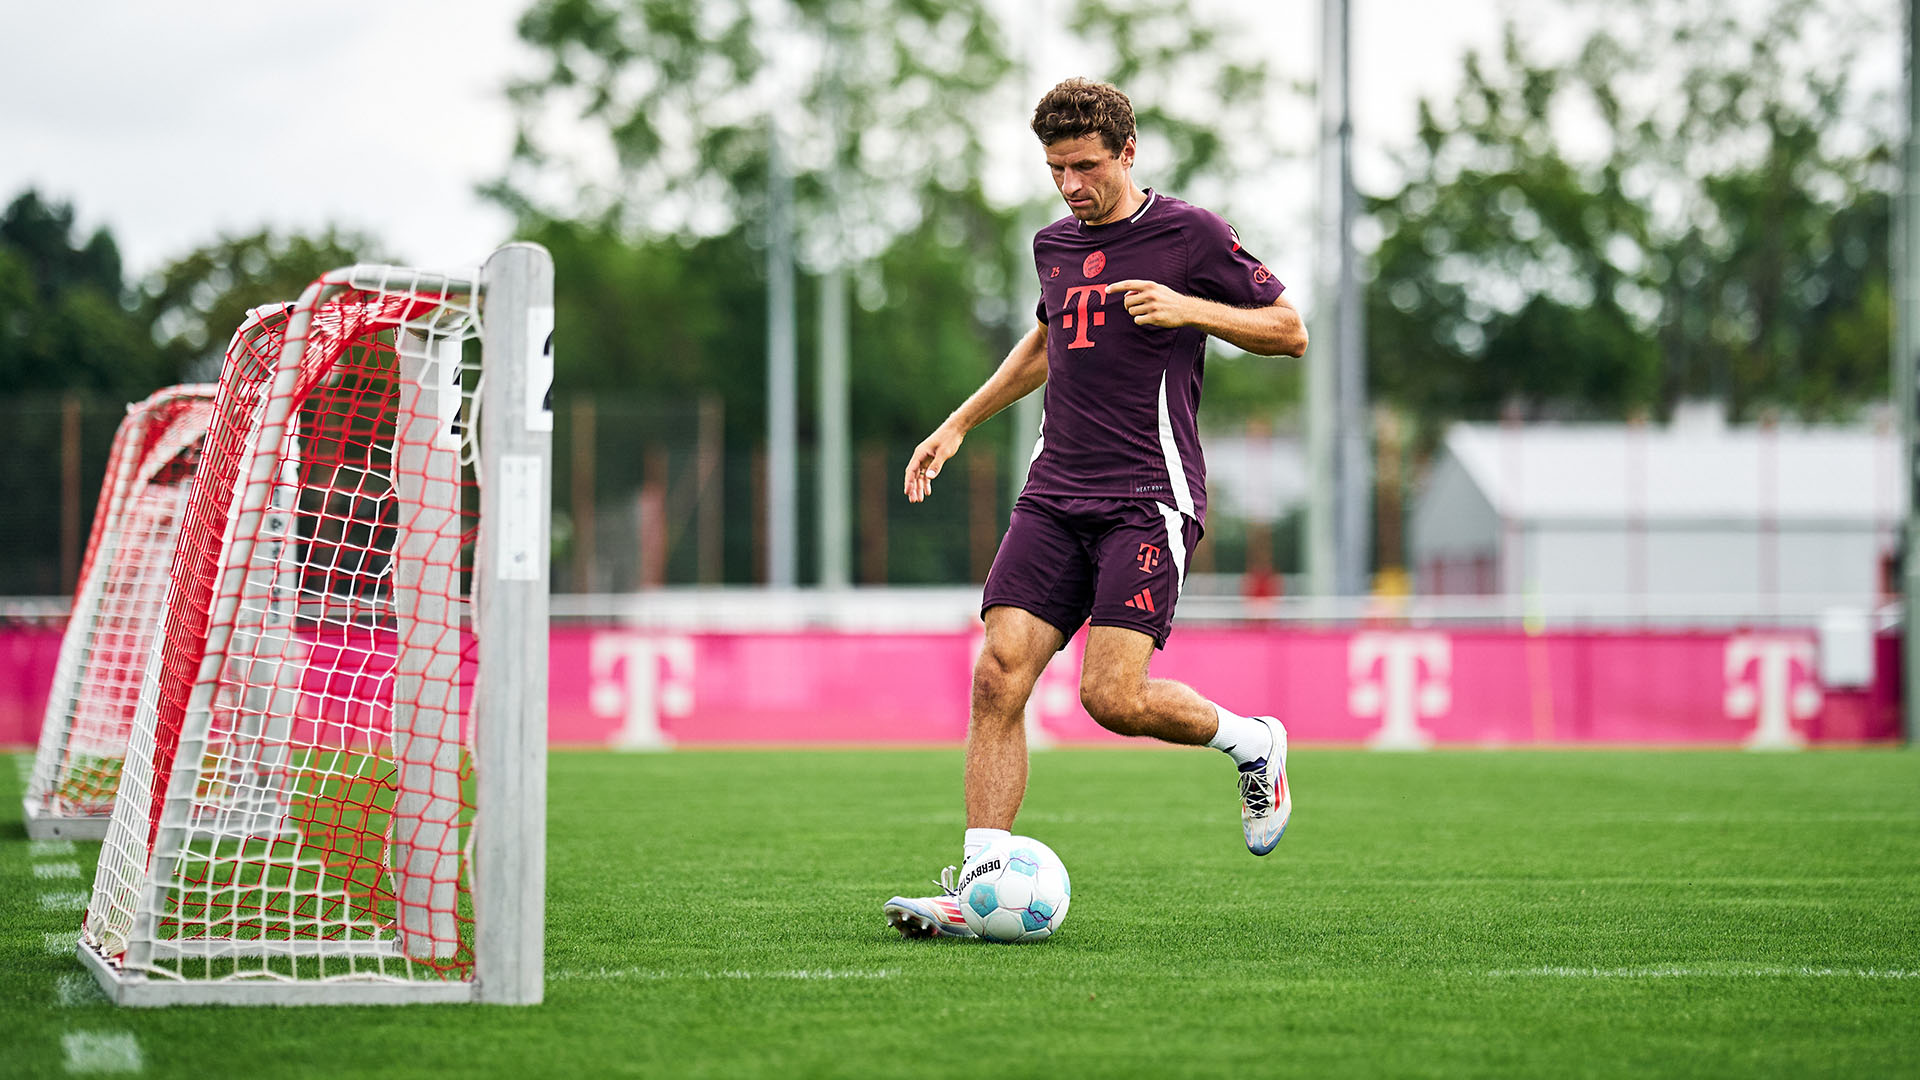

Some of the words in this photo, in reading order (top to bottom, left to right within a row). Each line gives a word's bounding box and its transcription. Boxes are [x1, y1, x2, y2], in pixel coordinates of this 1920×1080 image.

[1062, 283, 1108, 350] T
[1136, 542, 1161, 574] T
[589, 631, 696, 752] T
[1347, 631, 1454, 752] T
[1723, 634, 1822, 752] T
